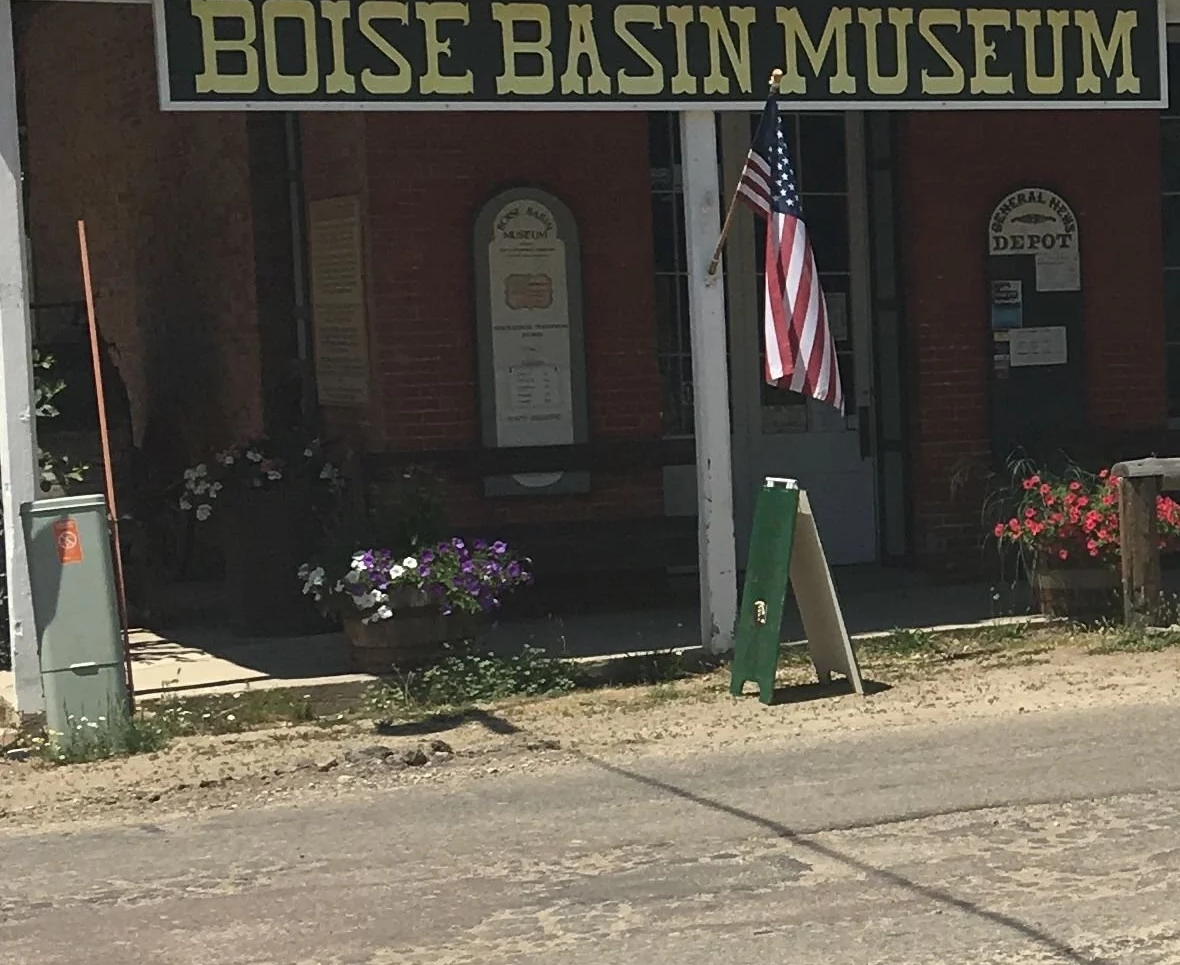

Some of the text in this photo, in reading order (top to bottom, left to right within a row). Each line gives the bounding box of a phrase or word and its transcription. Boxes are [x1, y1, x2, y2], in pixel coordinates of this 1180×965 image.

[491, 1, 756, 95] BASIN
[776, 5, 1141, 95] MUSEUM
[992, 191, 1046, 233] GENERAL
[992, 234, 1073, 251] DEPOT
